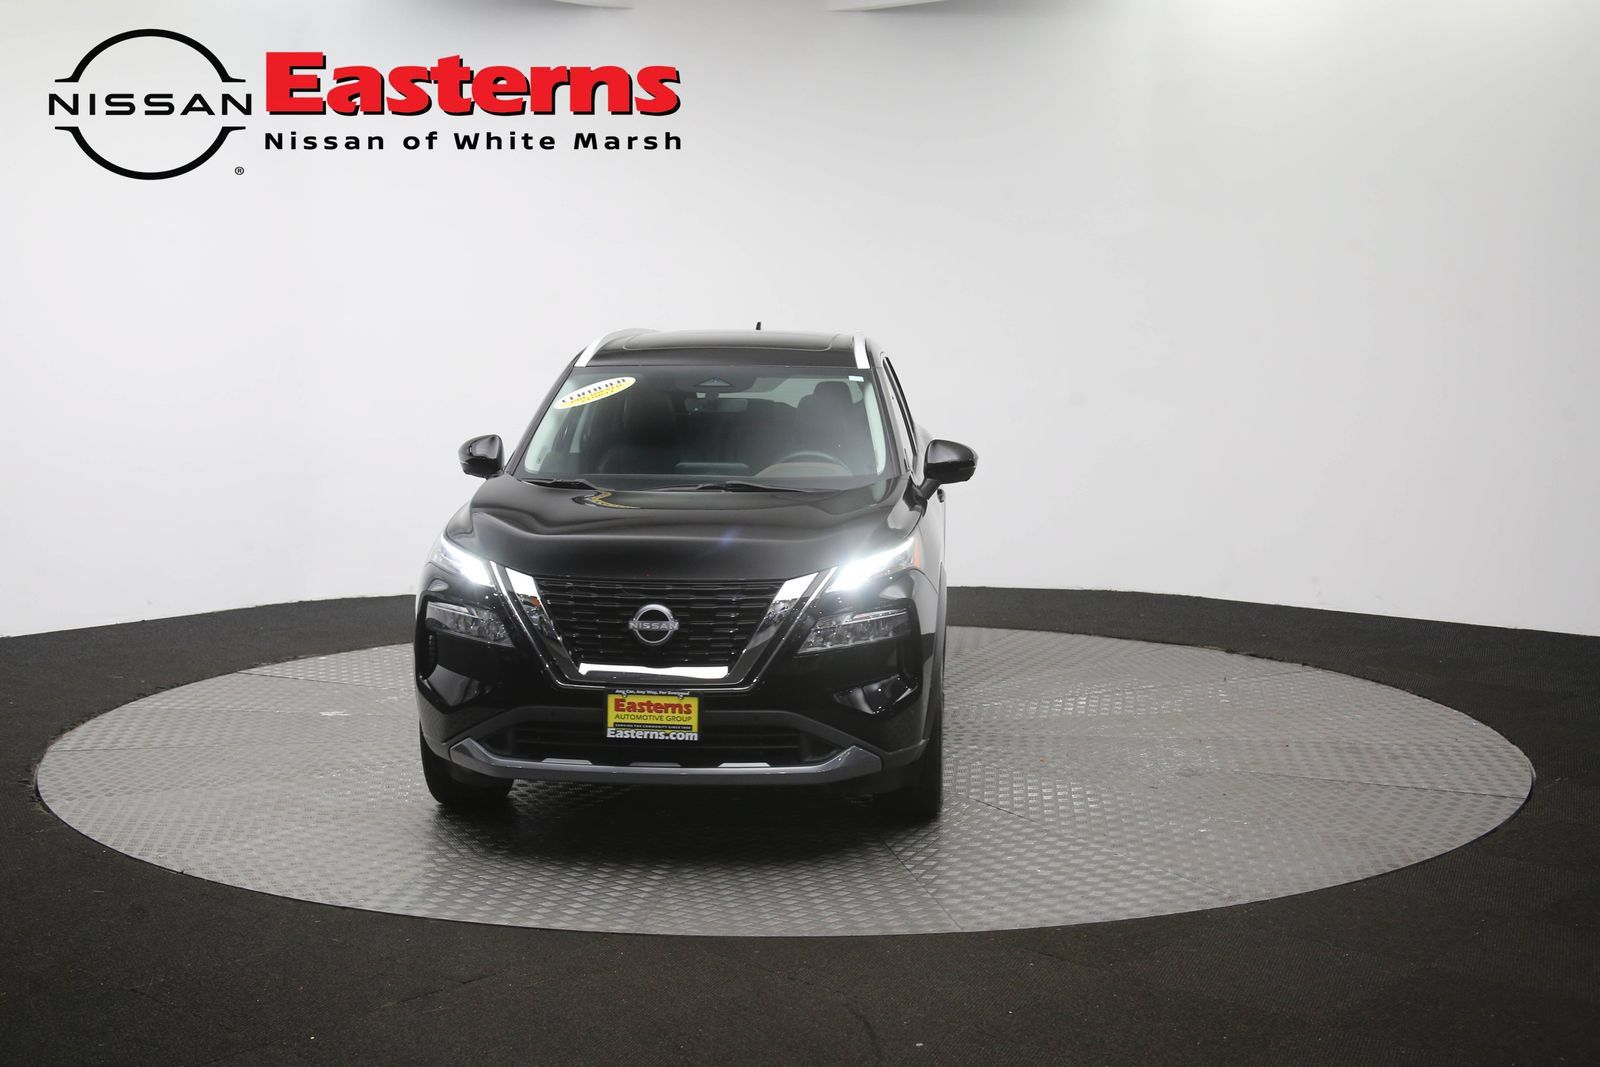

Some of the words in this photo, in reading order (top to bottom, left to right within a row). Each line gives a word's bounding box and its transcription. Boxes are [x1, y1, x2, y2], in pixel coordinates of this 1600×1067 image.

[628, 620, 679, 630] NISSAN
[614, 698, 692, 715] Easterns
[614, 713, 664, 722] AUTOMOTIVE
[665, 715, 692, 723] GROUP
[606, 727, 699, 741] Easterns.com
